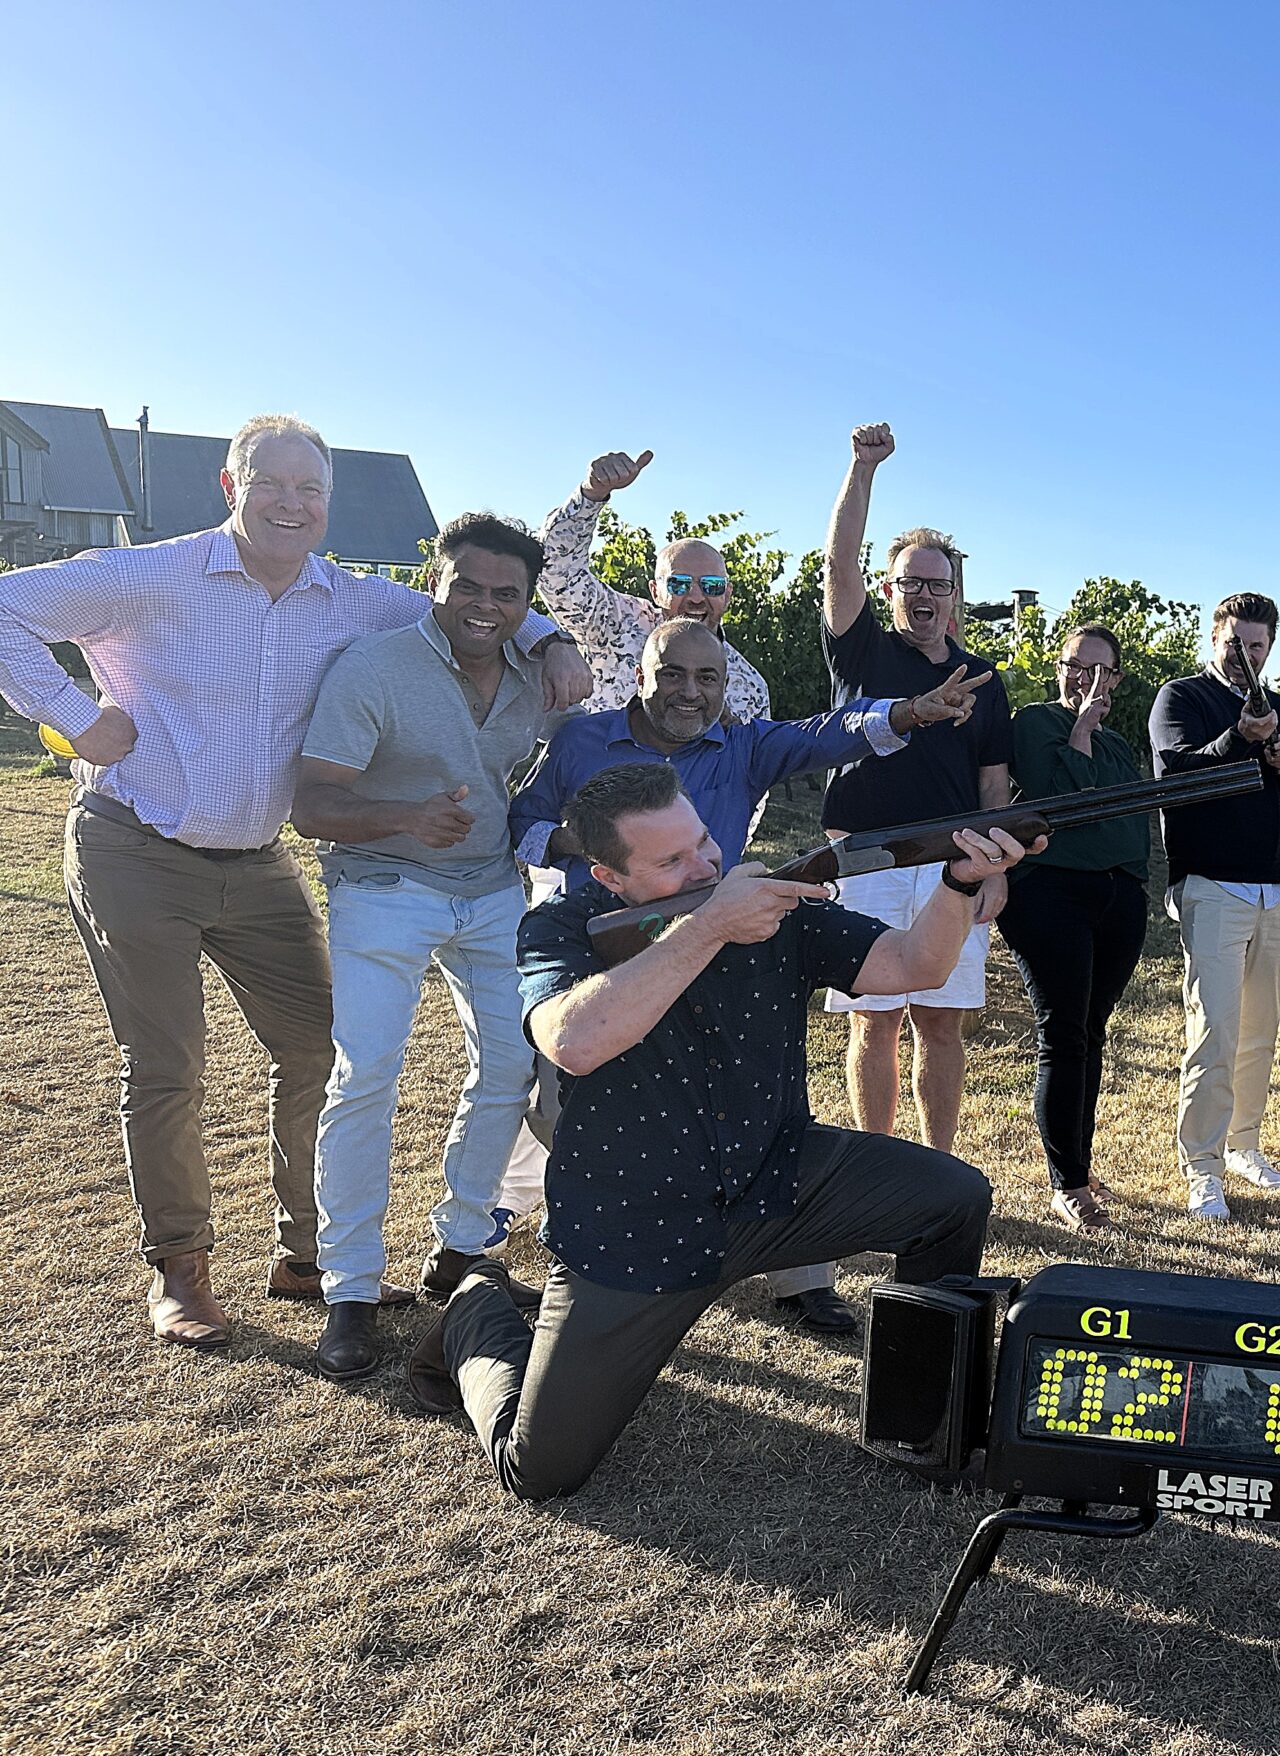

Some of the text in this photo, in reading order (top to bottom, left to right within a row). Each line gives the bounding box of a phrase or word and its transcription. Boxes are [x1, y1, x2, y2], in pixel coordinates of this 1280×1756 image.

[1081, 1307, 1132, 1339] G1
[1036, 1348, 1184, 1443] 02
[1157, 1470, 1273, 1502] LASER
[1156, 1493, 1272, 1519] SPORT
